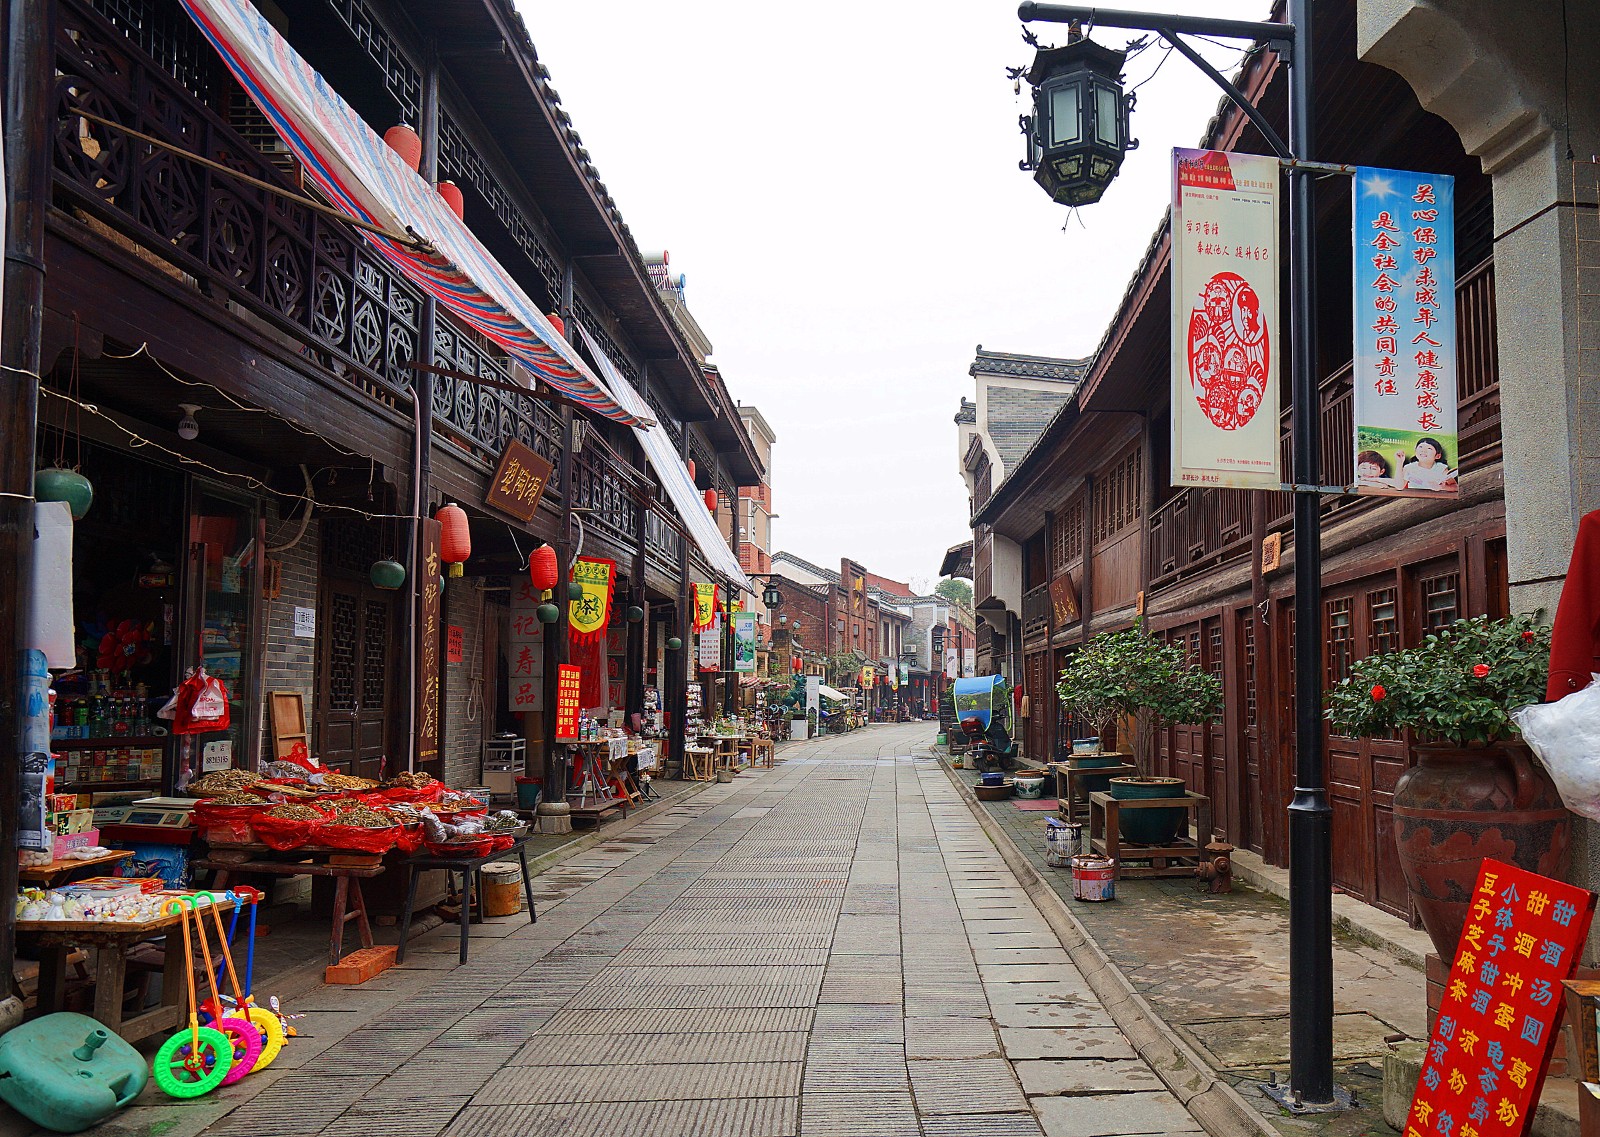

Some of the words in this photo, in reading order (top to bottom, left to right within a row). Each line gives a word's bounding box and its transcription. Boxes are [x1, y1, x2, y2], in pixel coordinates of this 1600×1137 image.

[1186, 220, 1219, 236] 学习雷锋
[1197, 241, 1230, 256] 奉献他人
[1235, 245, 1269, 260] 提升自己
[1371, 211, 1401, 396] 是全社会的共同责任
[1411, 183, 1443, 431] 关心保护未成年人健康成长
[513, 581, 539, 706] 文记寿品
[580, 598, 595, 616] 茶
[1449, 872, 1499, 1003] 豆子芝麻茶
[1470, 882, 1520, 1015] 小钵子甜酒
[1493, 890, 1550, 1032] 甜酒冲蛋
[1521, 900, 1577, 1047] 甜酒汤圆
[1423, 1015, 1457, 1092] 刮凉粉
[1447, 1028, 1480, 1095] 凉粉
[1468, 1040, 1505, 1126] 龟苓膏
[1495, 1056, 1532, 1128] 葛粉
